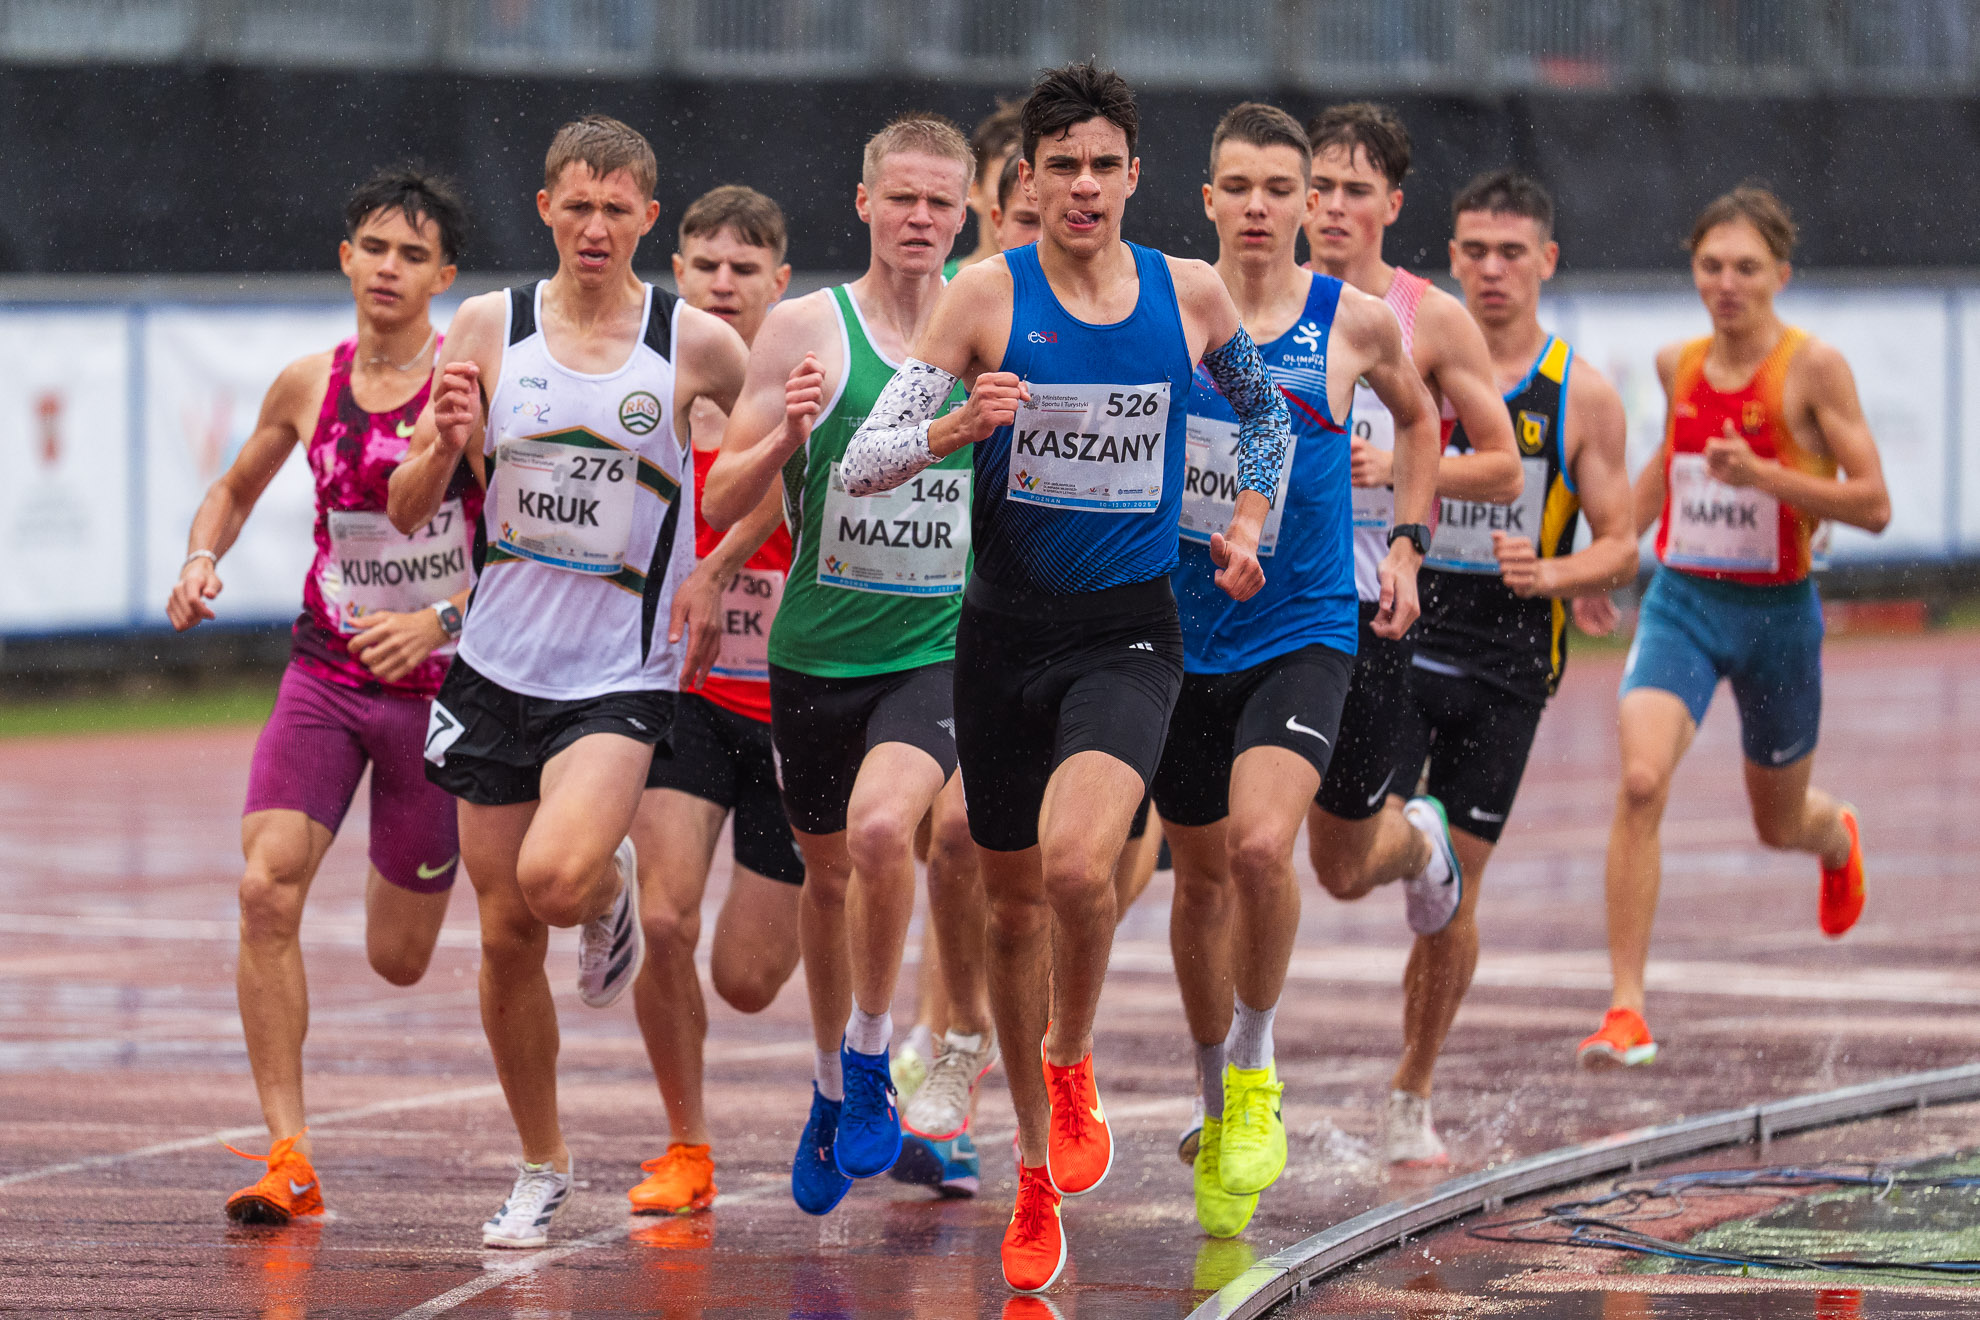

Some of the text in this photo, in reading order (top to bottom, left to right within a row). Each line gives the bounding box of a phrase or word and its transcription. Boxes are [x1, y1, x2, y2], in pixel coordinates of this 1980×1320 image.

[1028, 331, 1058, 344] esa
[625, 398, 656, 416] RKS
[1105, 392, 1158, 418] 526
[1016, 430, 1161, 464] KASZANY
[570, 456, 624, 483] 276
[911, 478, 960, 503] 146
[518, 488, 601, 528] KRUK
[1438, 502, 1524, 530] ILIPEK
[838, 516, 953, 549] MAZUR
[341, 547, 466, 588] KUROWSKI
[425, 710, 454, 752] 7
